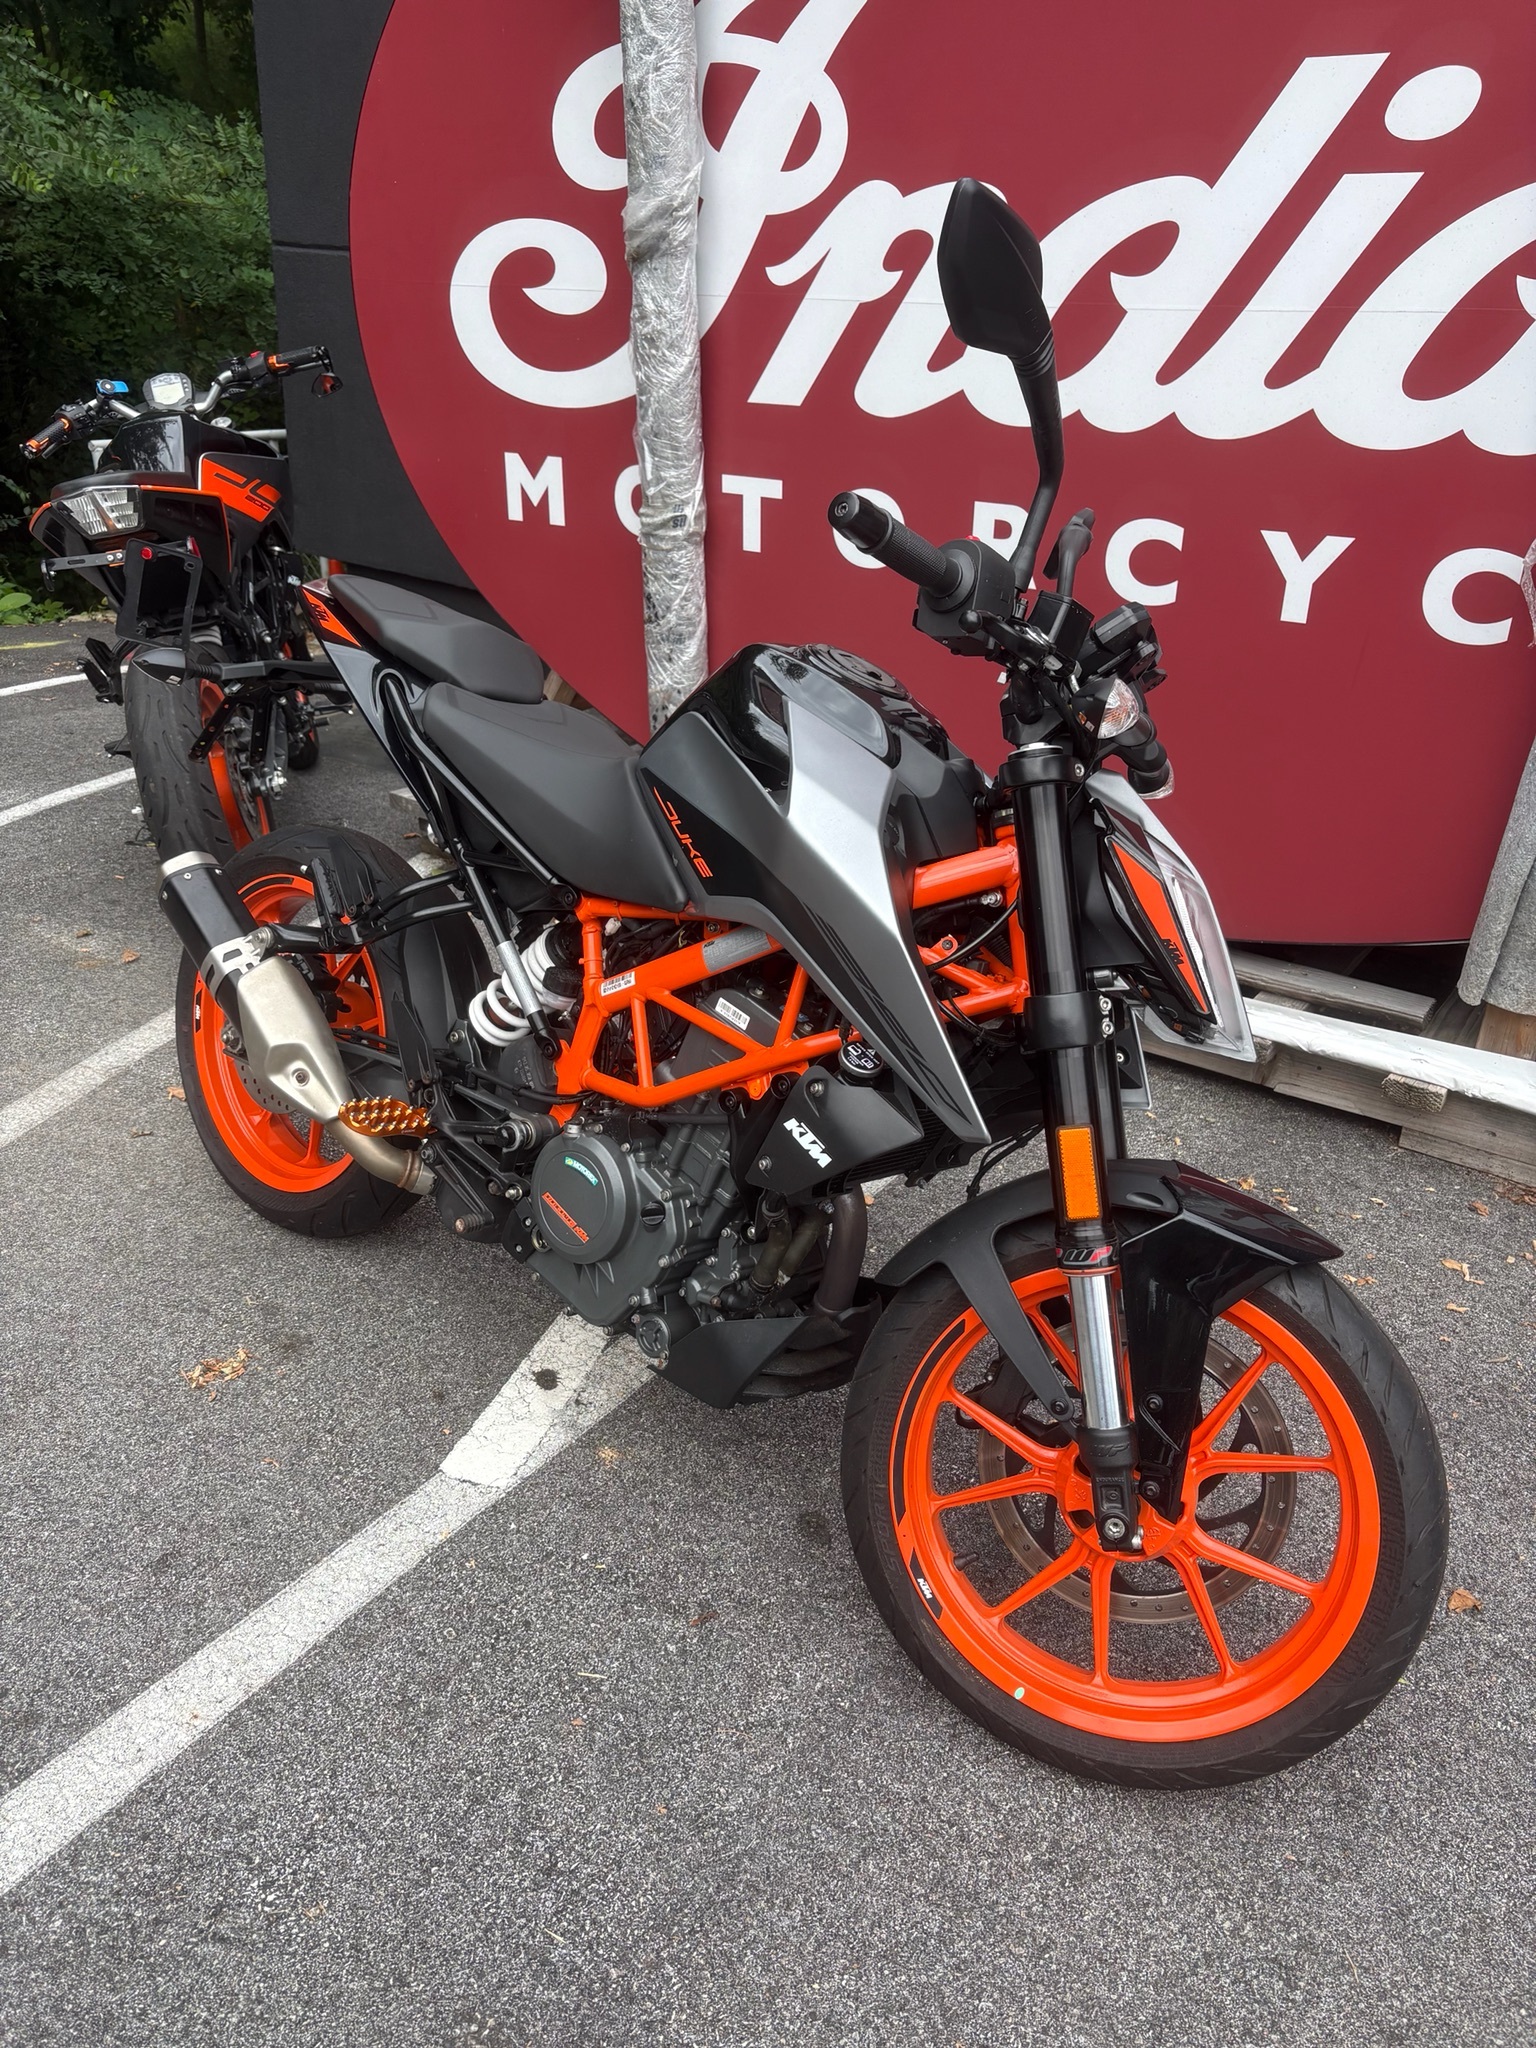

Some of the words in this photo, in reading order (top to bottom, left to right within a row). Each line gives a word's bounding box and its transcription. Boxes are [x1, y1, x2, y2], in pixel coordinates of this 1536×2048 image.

[653, 786, 713, 878] DUKE
[1161, 937, 1184, 966] KTM
[783, 1117, 833, 1169] KTM
[917, 1578, 933, 1599] KTM
